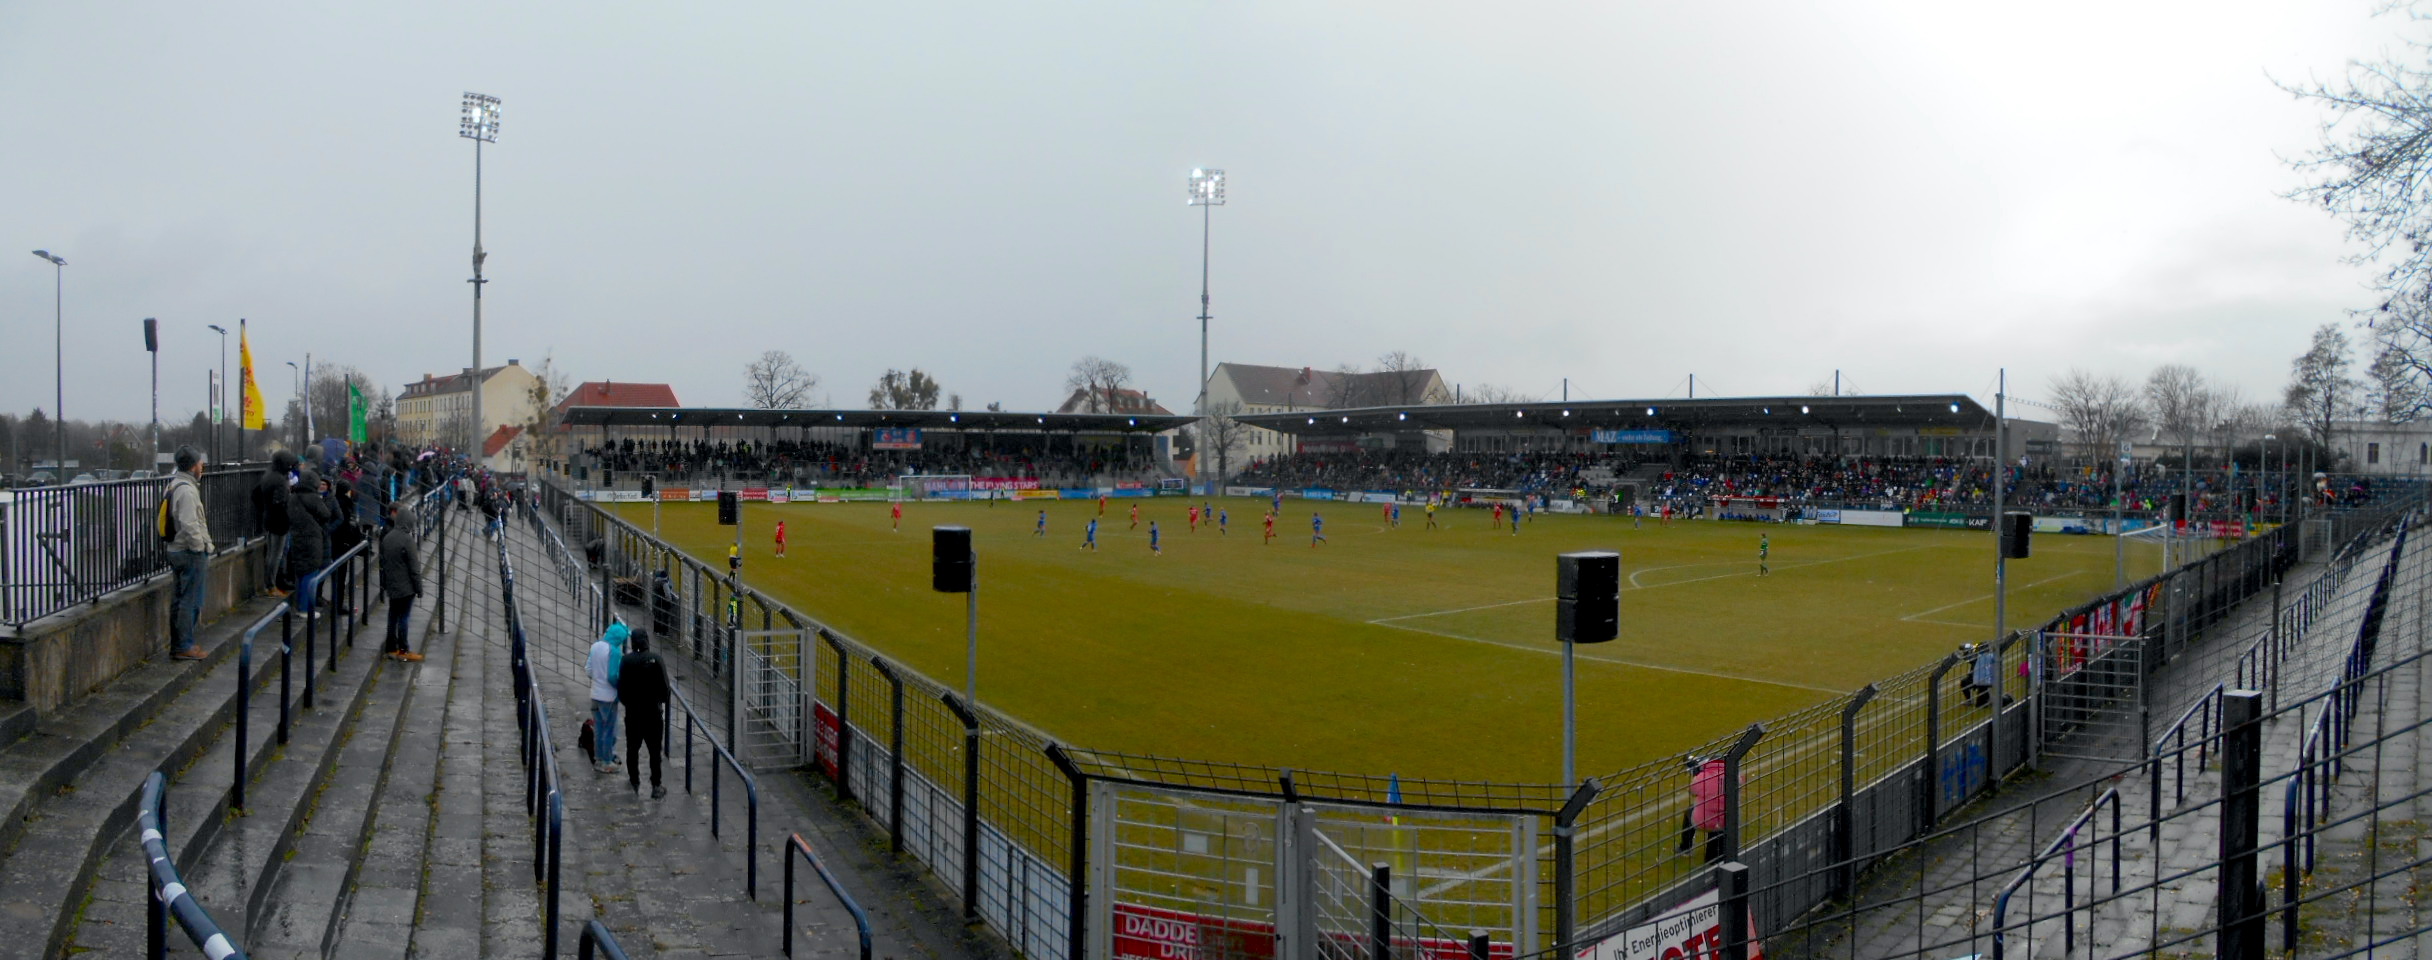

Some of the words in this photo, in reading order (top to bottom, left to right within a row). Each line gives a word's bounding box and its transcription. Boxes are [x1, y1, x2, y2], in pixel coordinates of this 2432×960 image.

[1597, 430, 1617, 442] MAZ
[970, 481, 985, 490] THE
[986, 481, 1013, 490] FLYING
[1014, 481, 1038, 491] STARS
[1125, 915, 1203, 944] DADDE
[1632, 905, 1718, 955] Energieoptimierer
